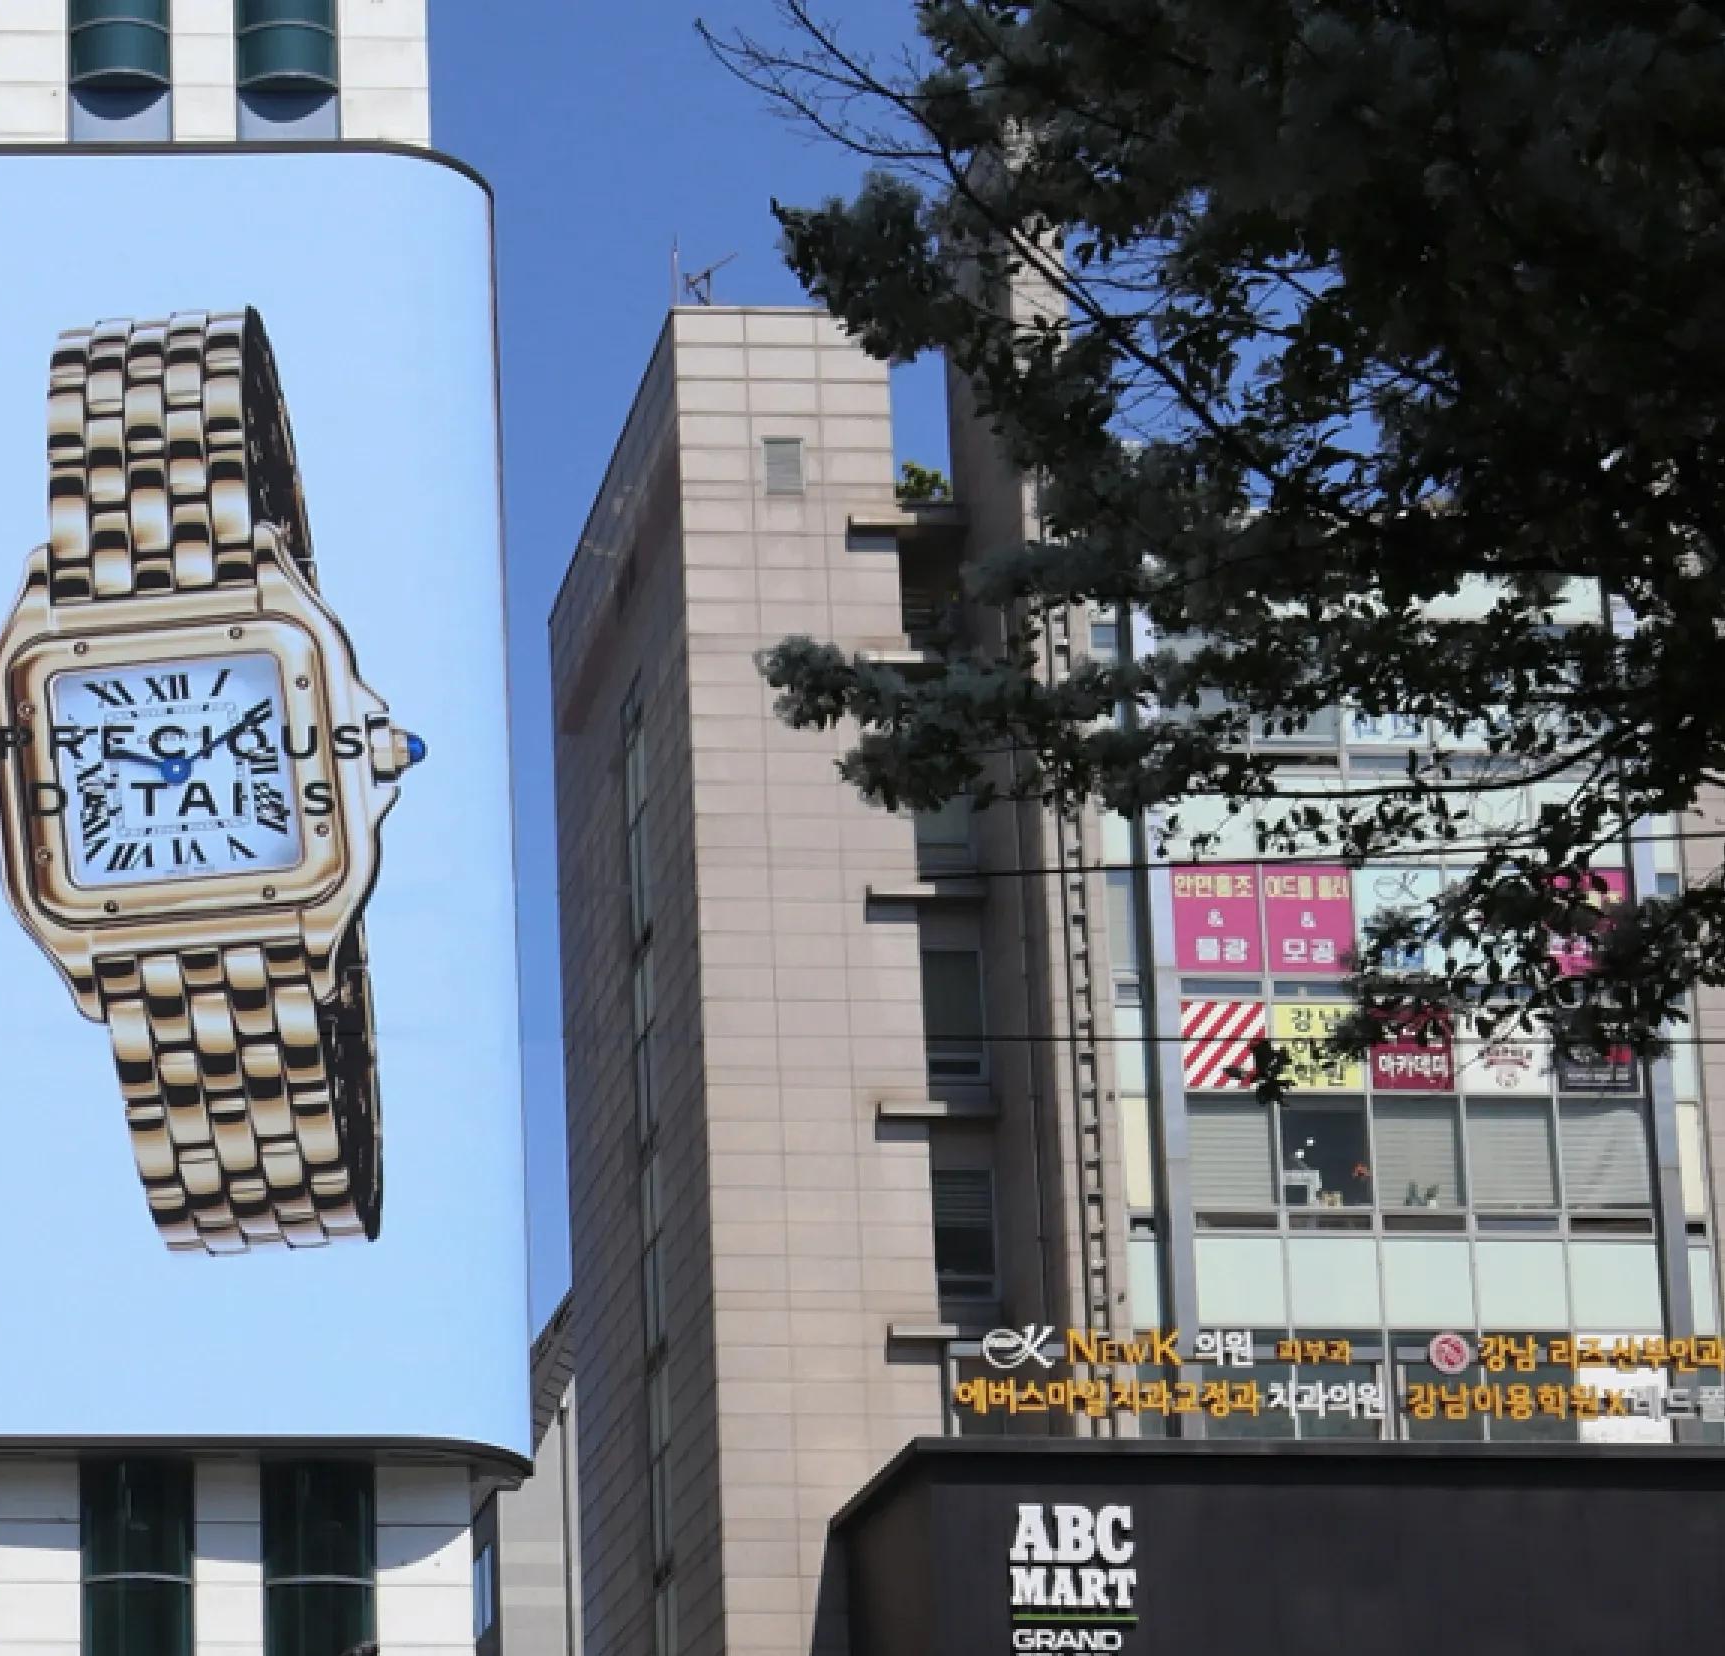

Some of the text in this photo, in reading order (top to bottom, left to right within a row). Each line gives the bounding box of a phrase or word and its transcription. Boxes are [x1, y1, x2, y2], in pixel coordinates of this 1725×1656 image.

[29, 781, 336, 818] DTAIS
[1207, 908, 1224, 928] &
[1301, 911, 1316, 928] &
[1282, 939, 1335, 963] 모공
[1379, 1052, 1448, 1079] 아카데미
[1194, 1331, 1255, 1366] 의원
[1274, 1339, 1351, 1365] 피부과
[1479, 1336, 1538, 1373] 강남
[1268, 1379, 1384, 1420] 치과의원
[1410, 1383, 1598, 1420] 강남이용학원
[1009, 1503, 1134, 1564] ABC
[1009, 1567, 1137, 1607] MART
[1013, 1628, 1122, 1651] GRAND
